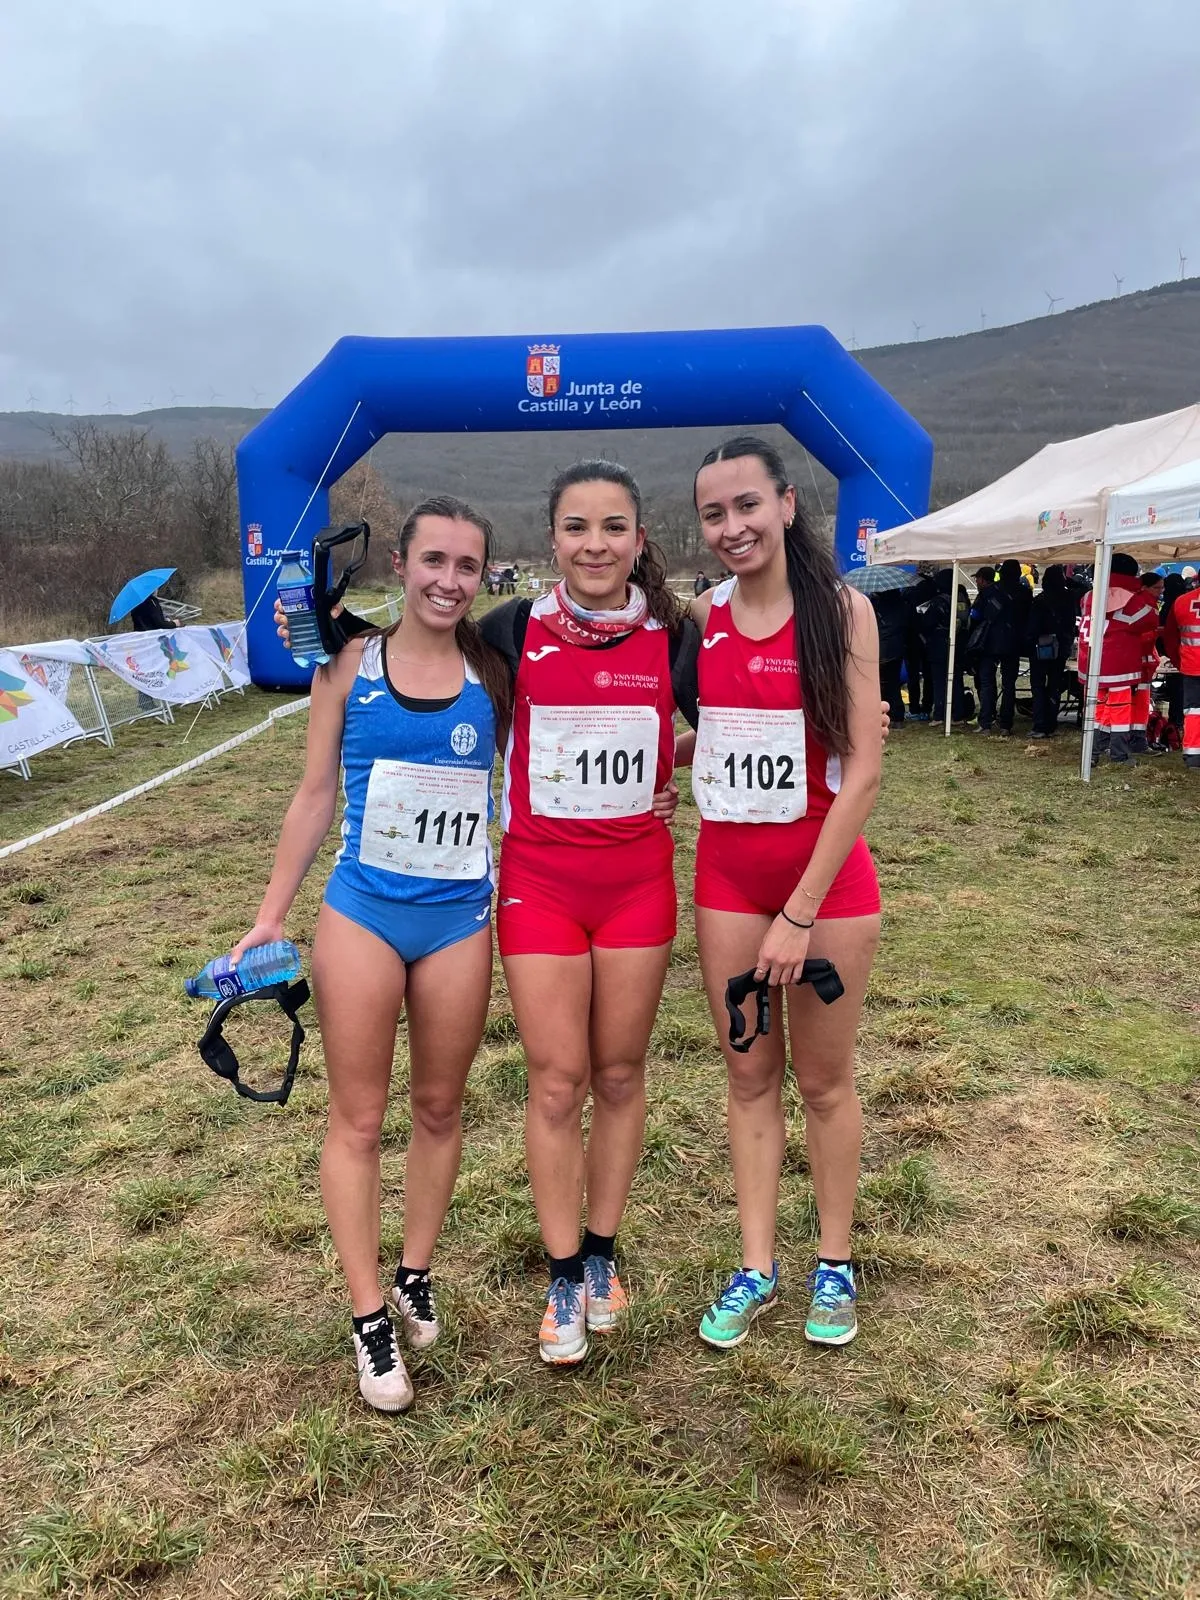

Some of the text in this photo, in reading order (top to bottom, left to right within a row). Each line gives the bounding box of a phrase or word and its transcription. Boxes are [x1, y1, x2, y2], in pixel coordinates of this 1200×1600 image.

[566, 380, 643, 396] Junta de
[518, 397, 641, 414] Castilla y León
[245, 557, 273, 566] Castilla
[765, 658, 797, 667] VNIVERSI
[613, 673, 659, 683] VNIVERSIDAD
[7, 719, 76, 754] CASTILLA Y LEÓ
[575, 749, 644, 785] 1101
[724, 752, 795, 791] 1102
[414, 808, 480, 847] 1117
